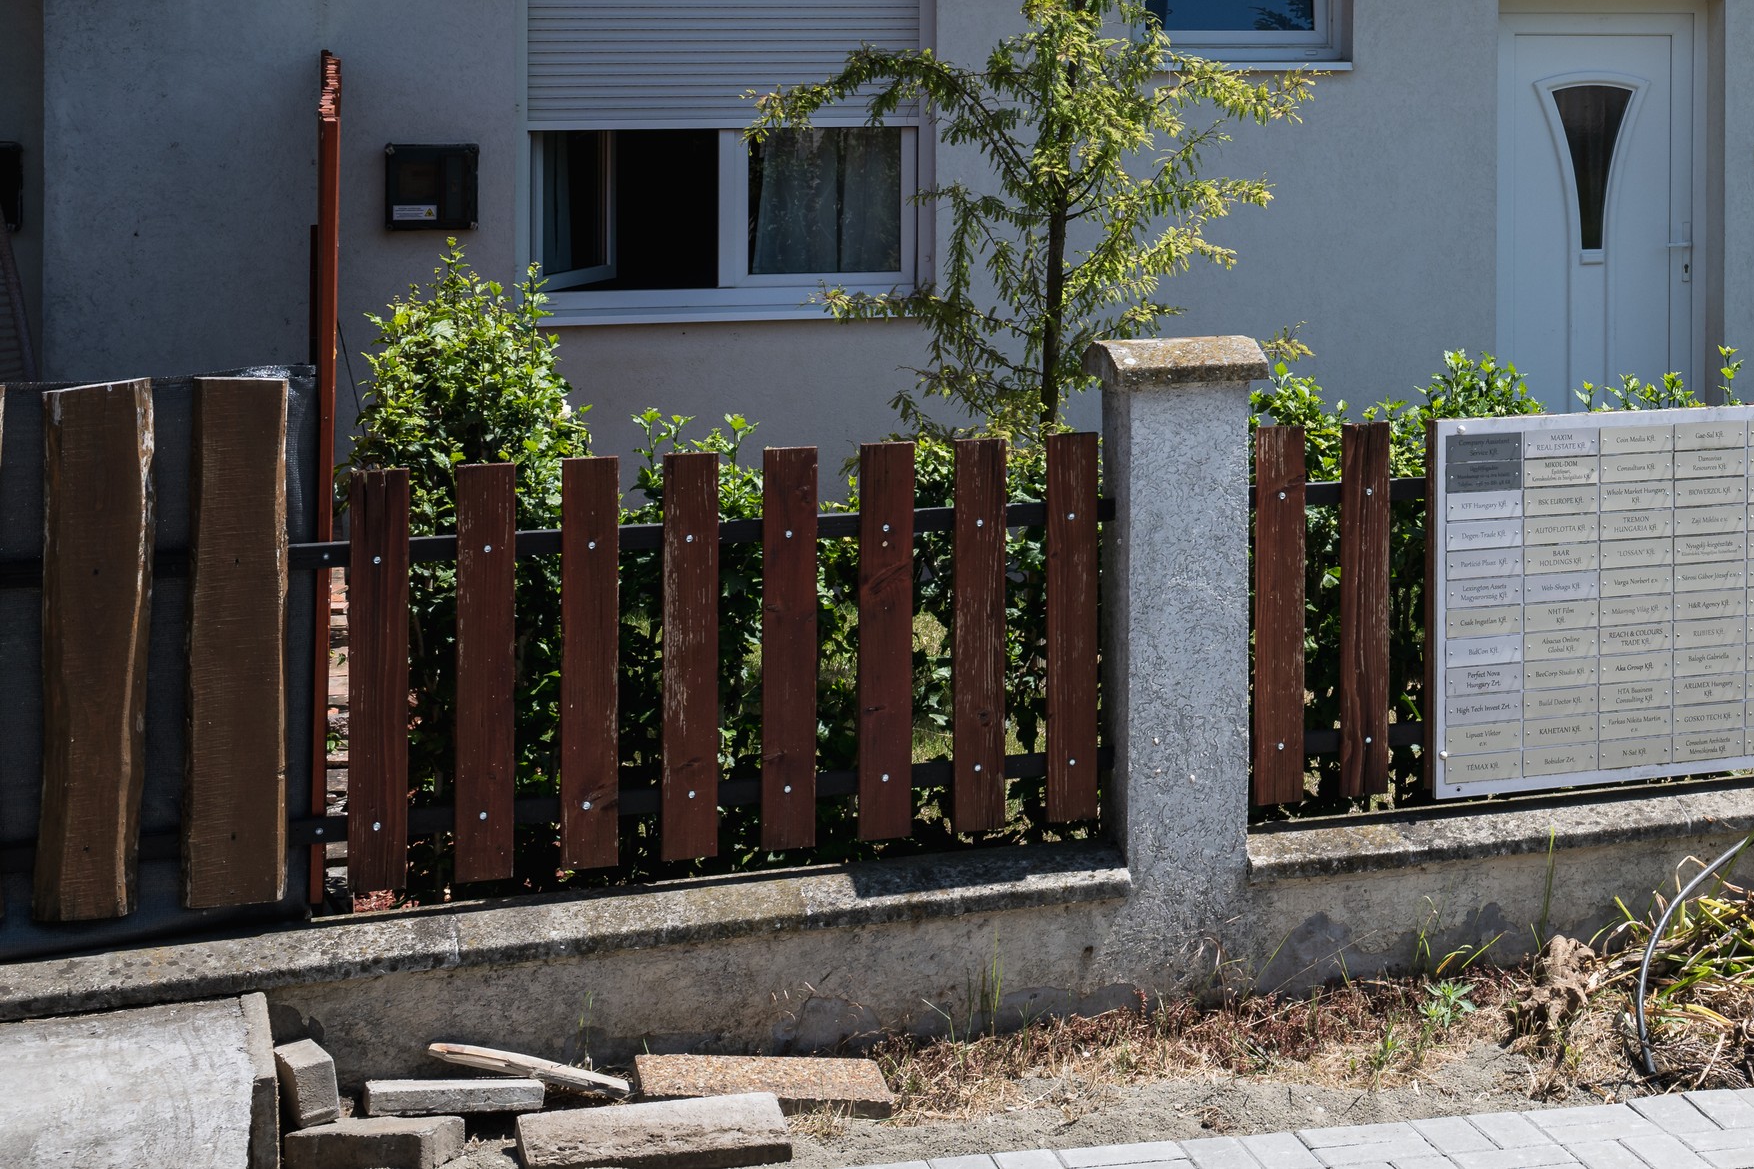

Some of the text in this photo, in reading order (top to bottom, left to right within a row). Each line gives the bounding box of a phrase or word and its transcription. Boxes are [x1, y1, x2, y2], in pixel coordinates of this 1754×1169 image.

[1554, 443, 1576, 451] ESTATE
[1550, 497, 1574, 505] EUROPE
[1614, 525, 1648, 533] HUNGARIA
[1553, 549, 1570, 557] BAAR
[1540, 558, 1573, 567] HOLDINGS
[1461, 593, 1498, 603] Magyarország
[1702, 602, 1720, 610] Agency
[1609, 631, 1629, 639] REACH
[1636, 628, 1663, 636] COLOURS
[1548, 645, 1565, 653] Global
[1688, 652, 1729, 663] Balogh Gabriella
[1627, 664, 1644, 672] Group
[1468, 671, 1486, 680] Perfect
[1467, 682, 1491, 690] Hungary
[1456, 706, 1470, 715] High
[1539, 726, 1571, 735] KAHETANI
